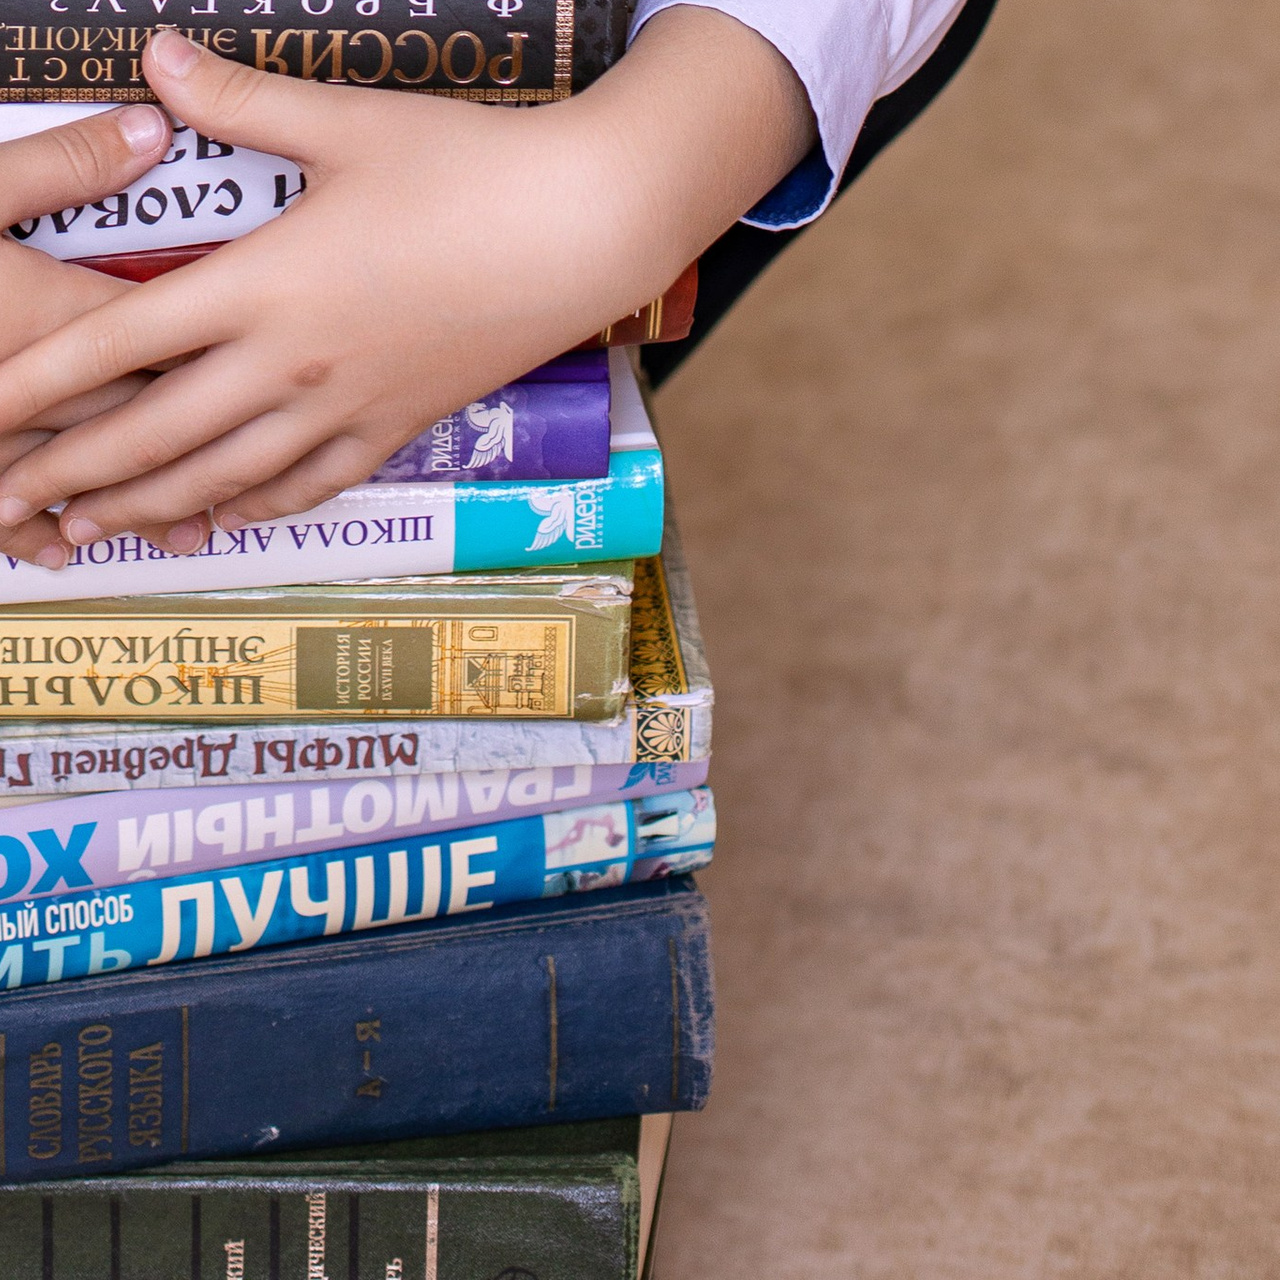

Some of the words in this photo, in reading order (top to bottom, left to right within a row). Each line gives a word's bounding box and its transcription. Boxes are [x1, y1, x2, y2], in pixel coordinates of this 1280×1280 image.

[250, 28, 529, 85] РОССИЯ
[287, 514, 434, 551] ШКОЛА
[336, 633, 351, 704] ИСТОРИЯ
[357, 639, 372, 701] РОССИИ
[52, 734, 237, 786] Древней
[44, 894, 134, 935] СПОСОБ
[147, 835, 499, 966] ЛУЧШЕ
[27, 1042, 62, 1159] СЛОВАРЬ
[77, 1024, 113, 1164] РУССКОГО
[128, 1042, 163, 1147] ЯЗЫКА
